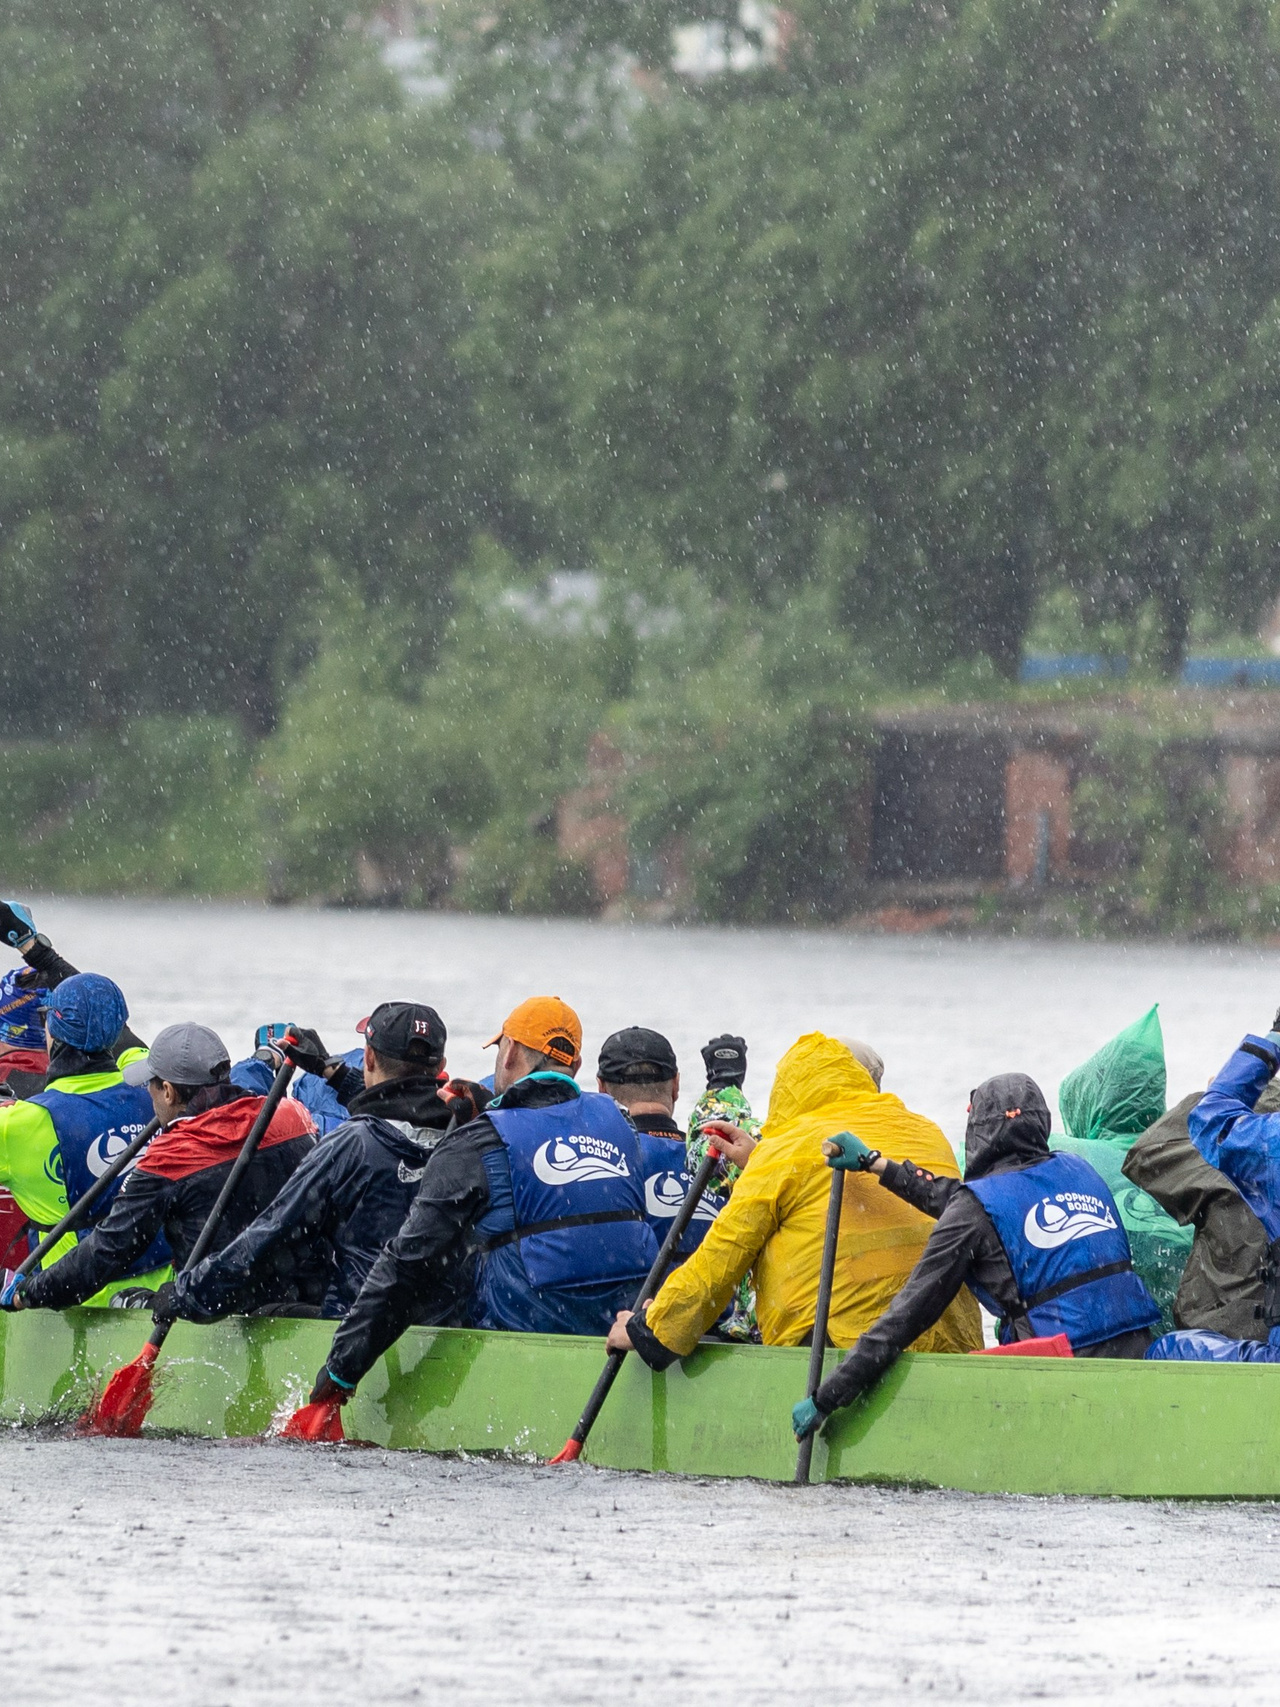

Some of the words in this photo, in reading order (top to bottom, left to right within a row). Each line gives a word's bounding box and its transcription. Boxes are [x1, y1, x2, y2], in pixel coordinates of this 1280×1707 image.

[568, 1135, 619, 1156] ФОРМУЛА
[579, 1144, 611, 1160] ВОДЫ
[1055, 1192, 1105, 1209] ФОРМУЛА
[1066, 1202, 1098, 1214] ВОДЫ
